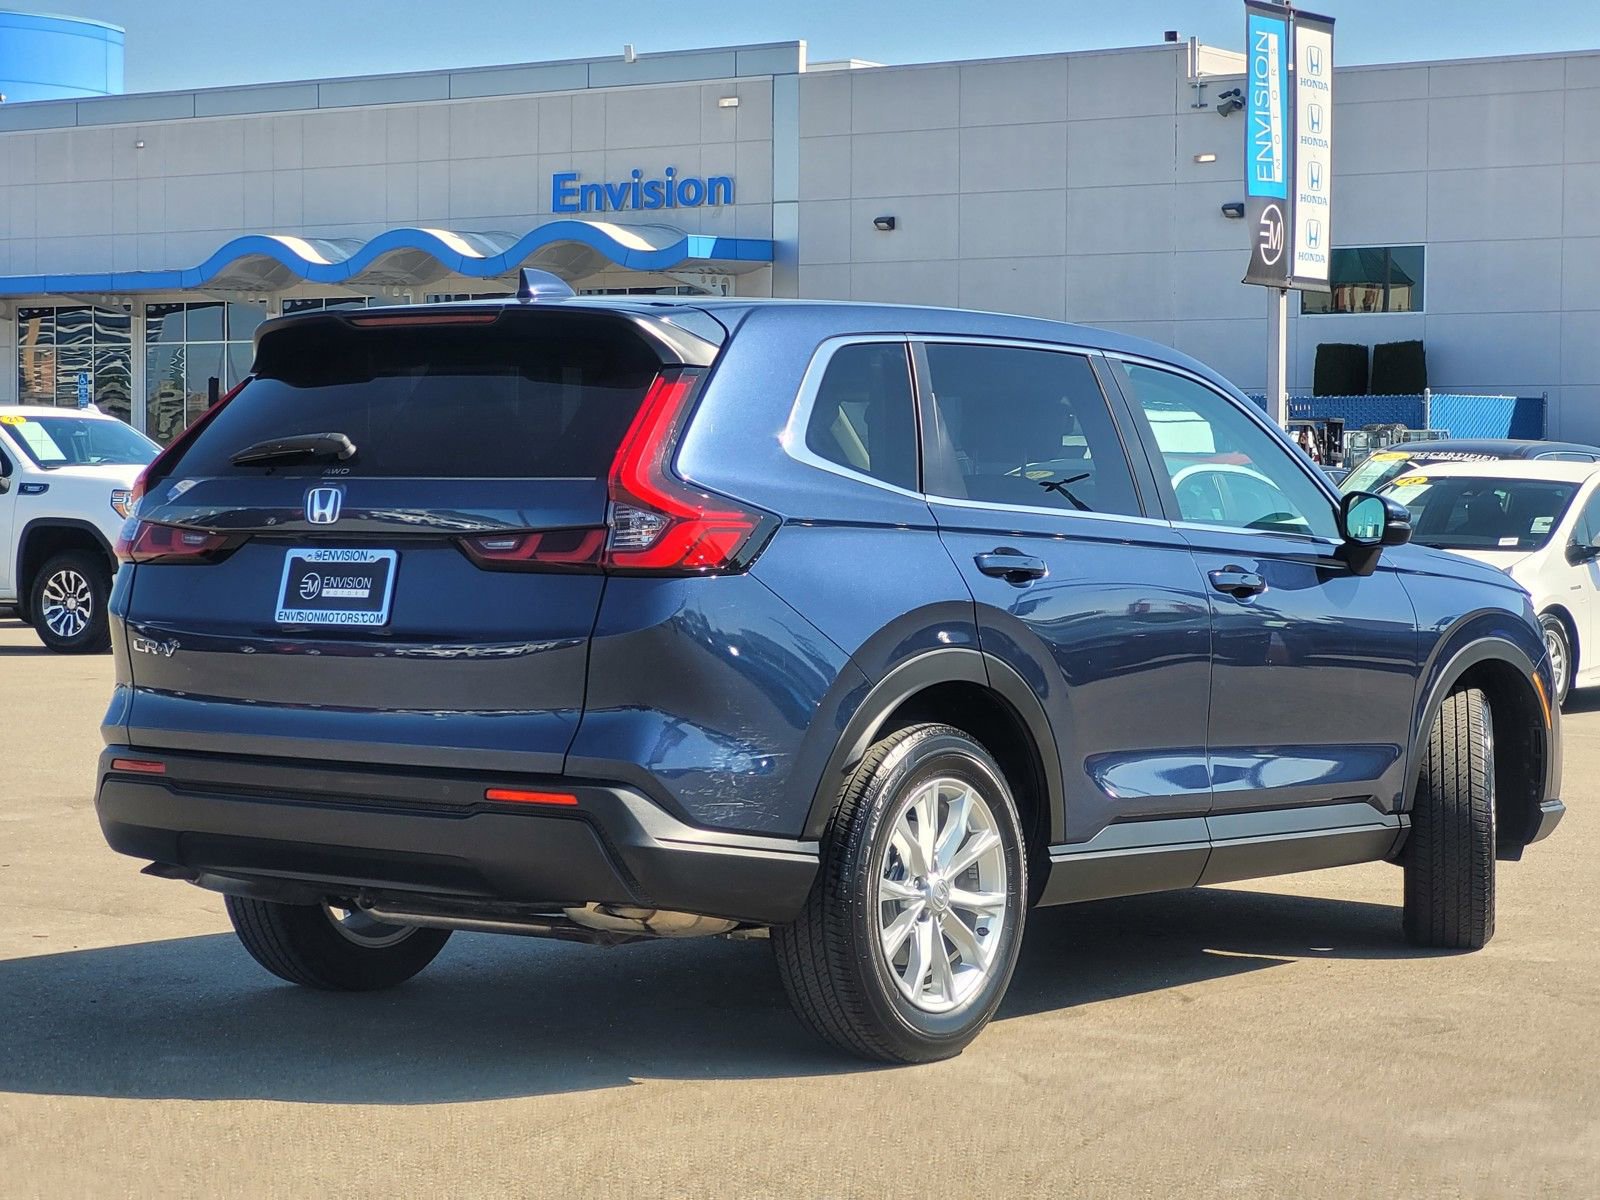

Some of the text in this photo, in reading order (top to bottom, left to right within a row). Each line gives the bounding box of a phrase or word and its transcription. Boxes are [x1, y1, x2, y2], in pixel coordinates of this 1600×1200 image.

[1299, 77, 1329, 92] HONDA
[1254, 30, 1275, 183] ENVISION
[1300, 135, 1329, 149] HONDA
[552, 167, 734, 213] Envision
[1299, 193, 1328, 206] HONDA
[1298, 251, 1326, 264] HONDA
[321, 550, 369, 561] ENVISION
[322, 576, 372, 589] ENVISION
[277, 611, 384, 624] ENVISIONMOTORS.COM
[133, 637, 180, 657] CR-V
